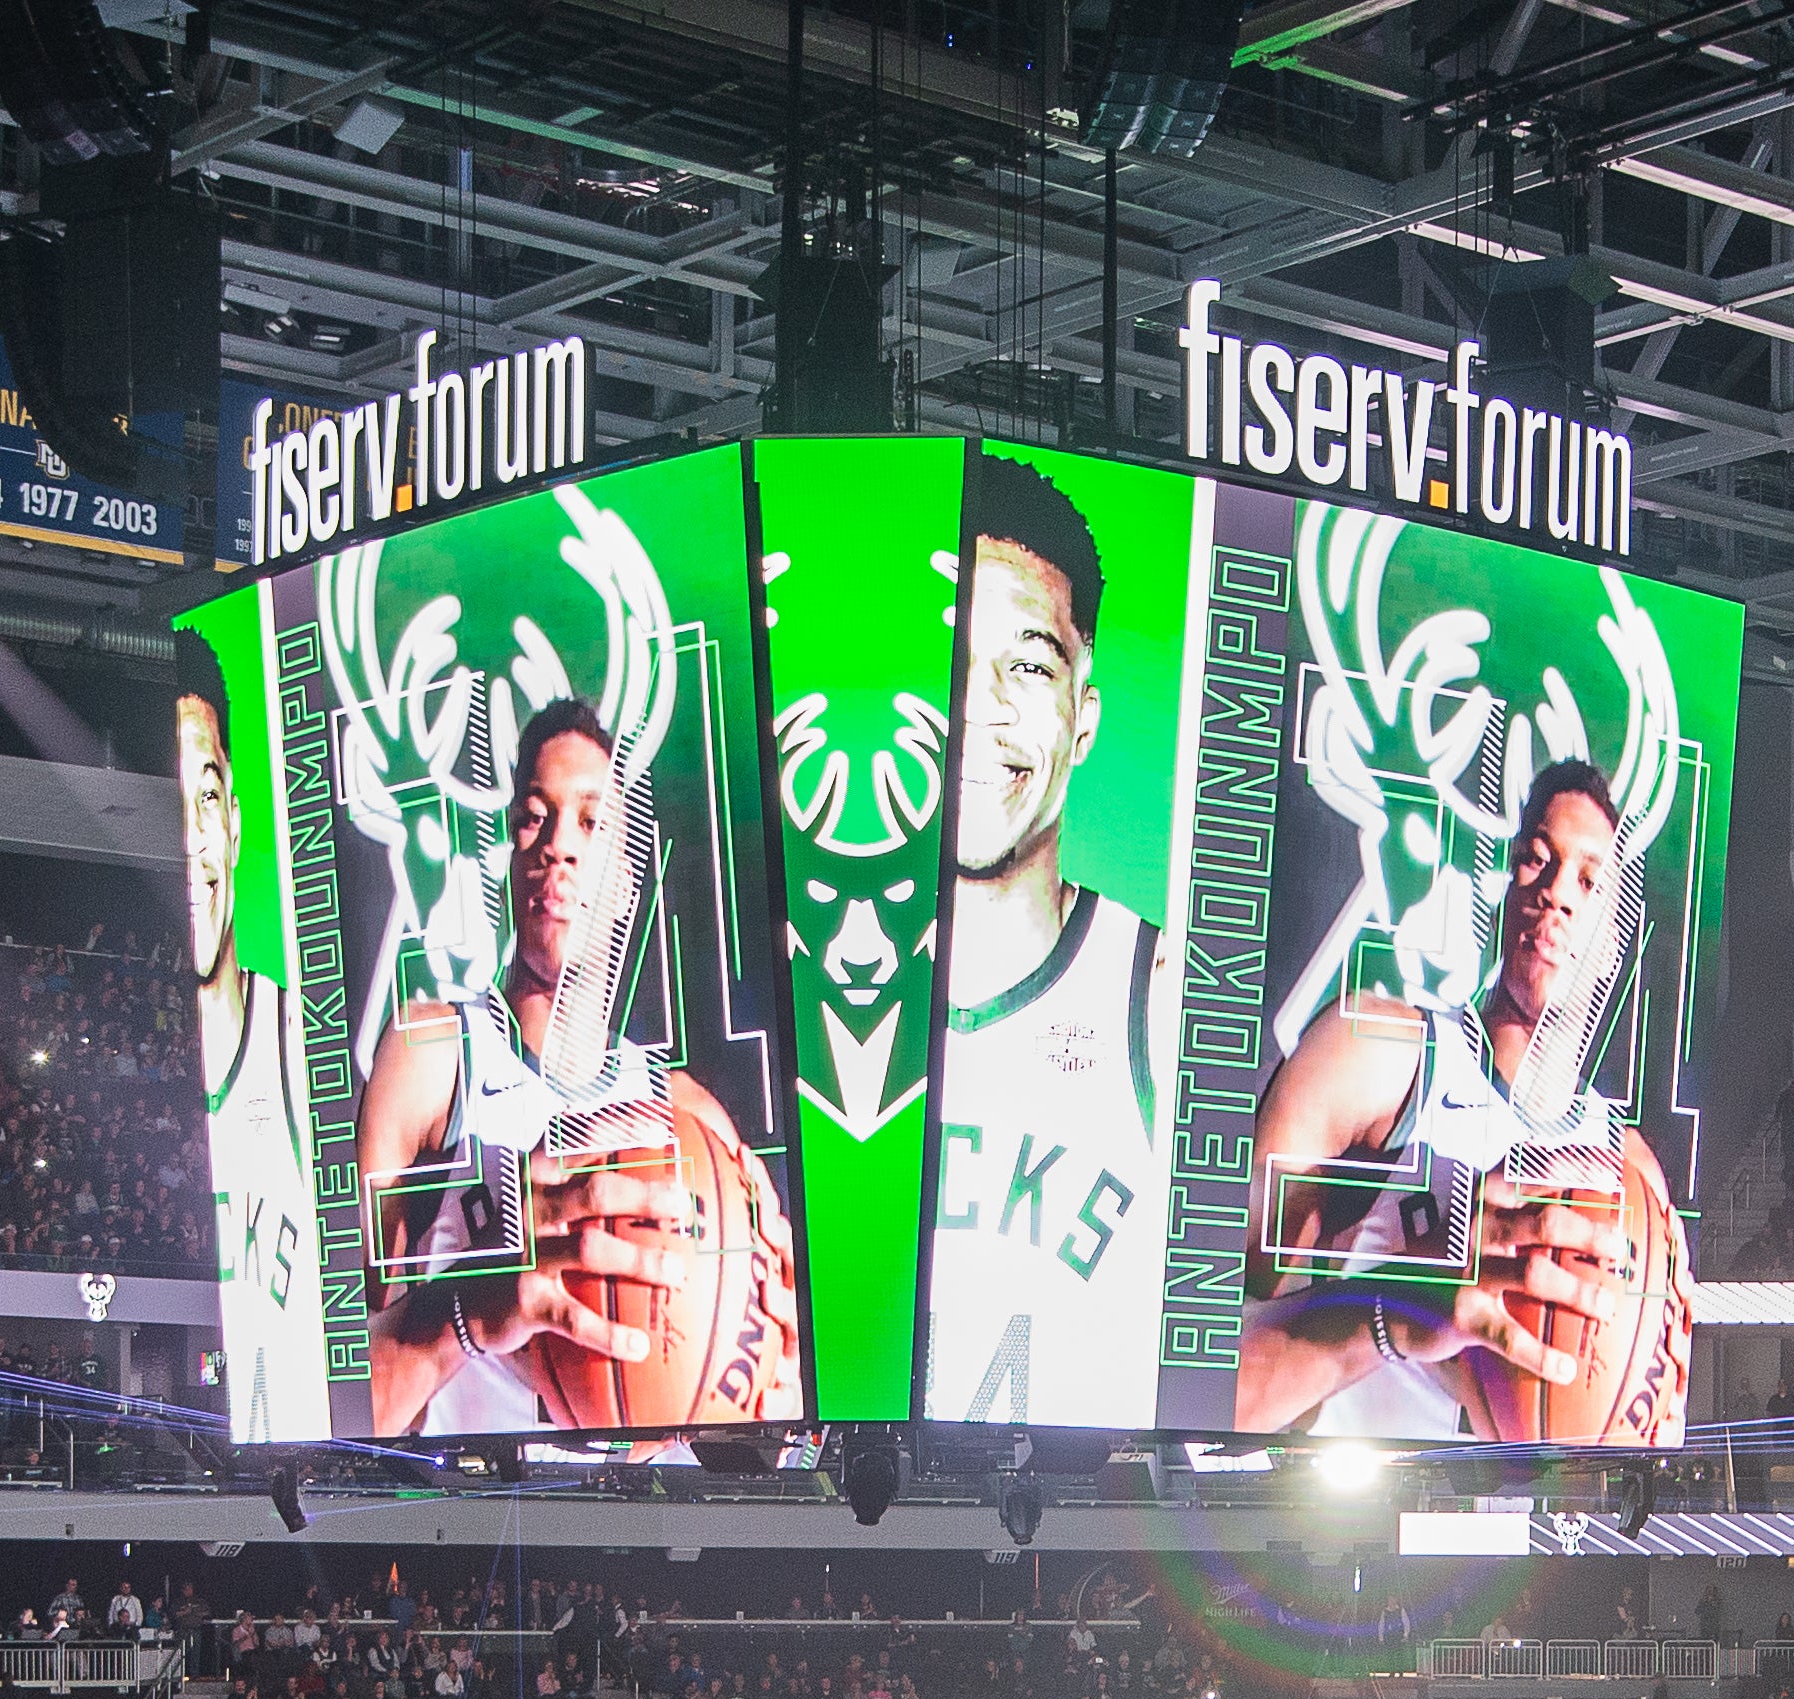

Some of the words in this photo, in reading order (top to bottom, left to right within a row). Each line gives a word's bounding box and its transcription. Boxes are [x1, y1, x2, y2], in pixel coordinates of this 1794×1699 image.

[20, 482, 79, 521] 1977
[93, 496, 158, 536] 2003
[250, 329, 589, 566] fiserv.forum
[1179, 278, 1633, 555] fiserv.forum
